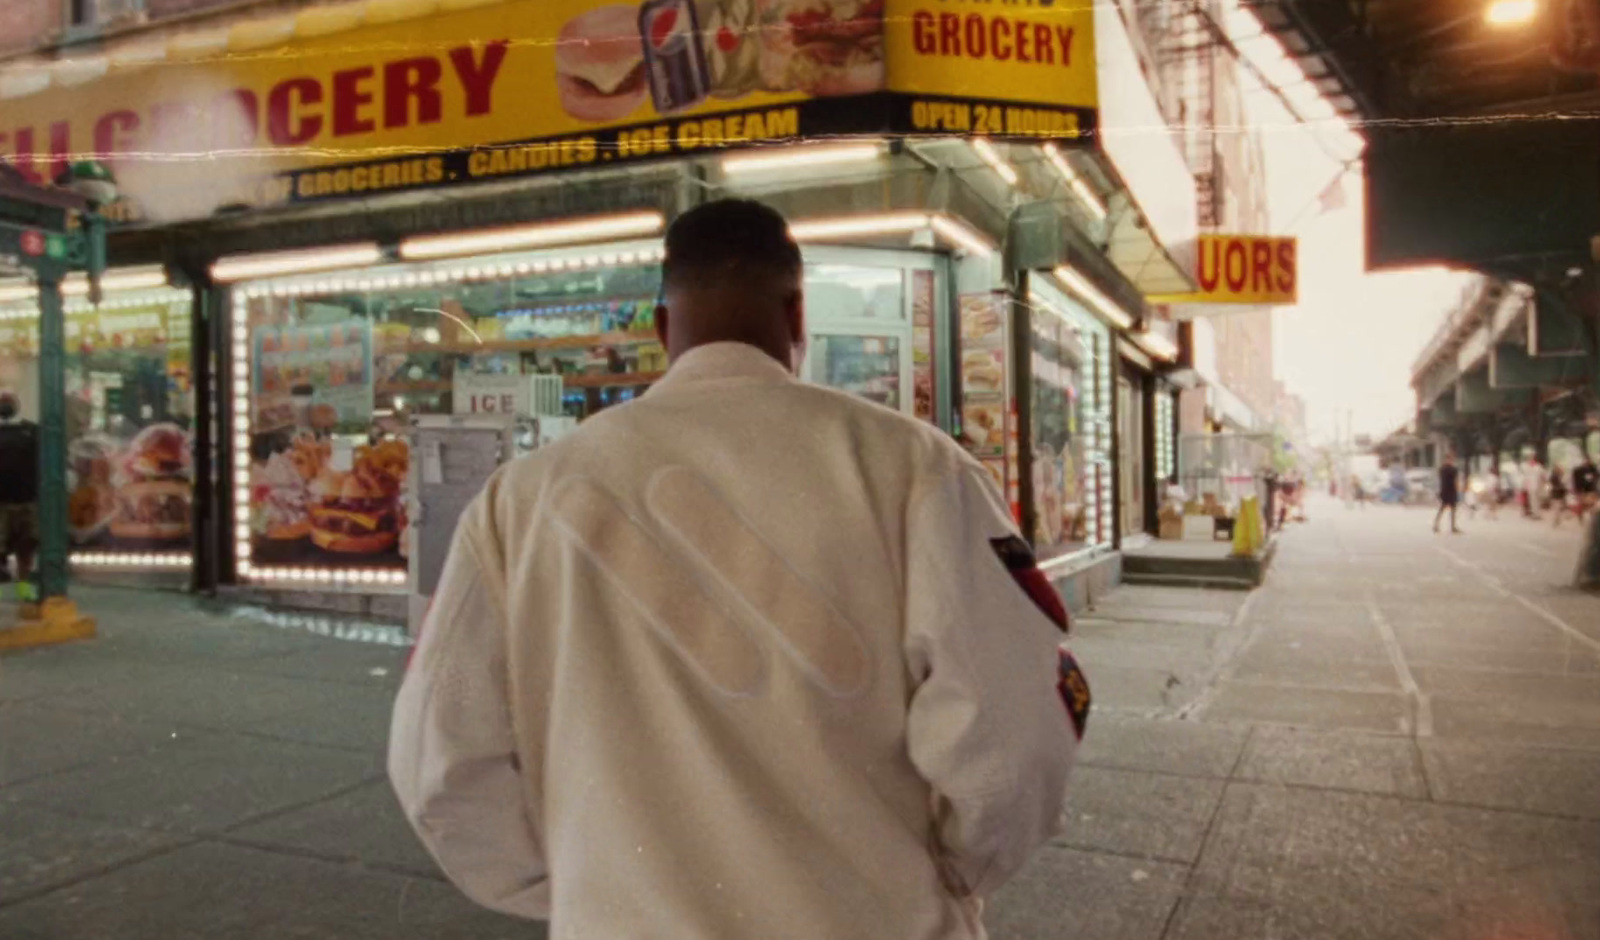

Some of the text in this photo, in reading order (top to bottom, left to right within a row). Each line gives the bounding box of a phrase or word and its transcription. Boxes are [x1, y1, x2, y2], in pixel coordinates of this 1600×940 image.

[912, 11, 1076, 67] GROCERY
[912, 101, 1080, 139] OPEN 24 HOURS
[297, 156, 443, 197] GROCERIES
[467, 136, 598, 177] CANDIES
[618, 125, 671, 156] ICE
[677, 108, 799, 149] CREAM
[470, 393, 514, 413] ICE
